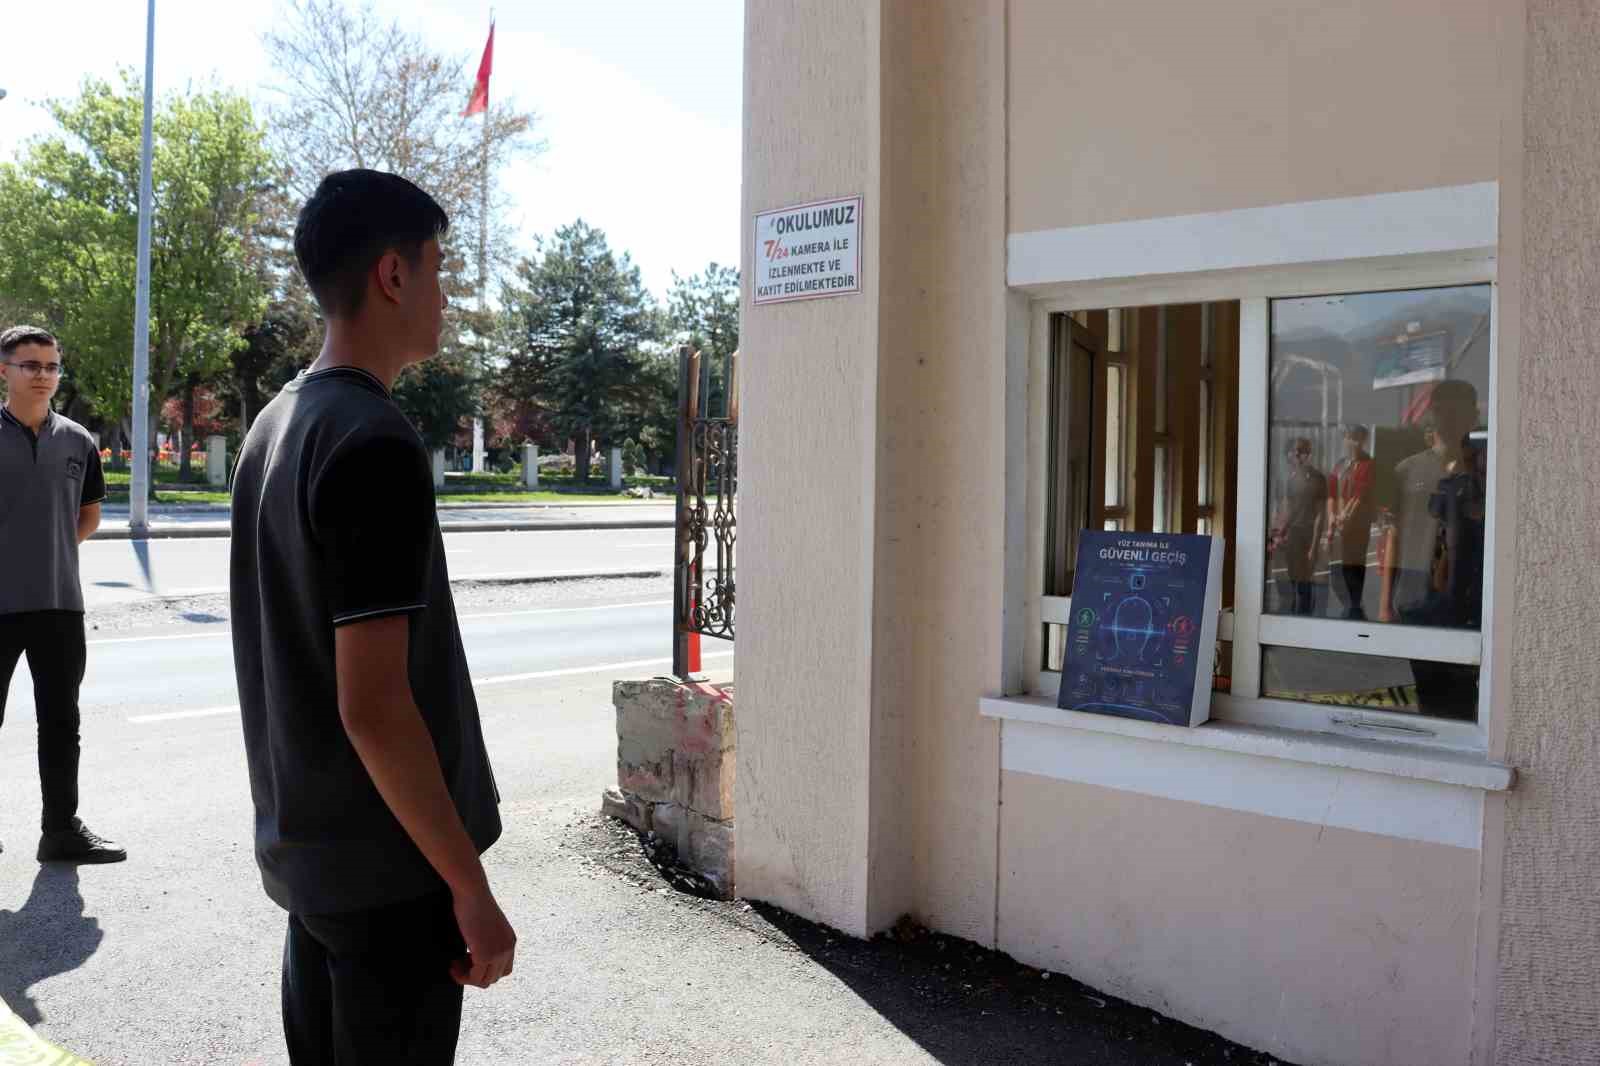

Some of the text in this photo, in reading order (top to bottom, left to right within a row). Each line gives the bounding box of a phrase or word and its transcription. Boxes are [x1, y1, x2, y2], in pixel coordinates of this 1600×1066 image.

[776, 205, 855, 235] OKULUMUZ
[763, 237, 849, 262] 7/24 KAMERA İLE
[768, 258, 841, 279] İZLENMEKTE VE
[757, 274, 855, 297] KAYIT EDİLMEKTEDİR
[1099, 547, 1149, 561] GÜVENLİ
[1151, 550, 1187, 567] GEÇİŞ
